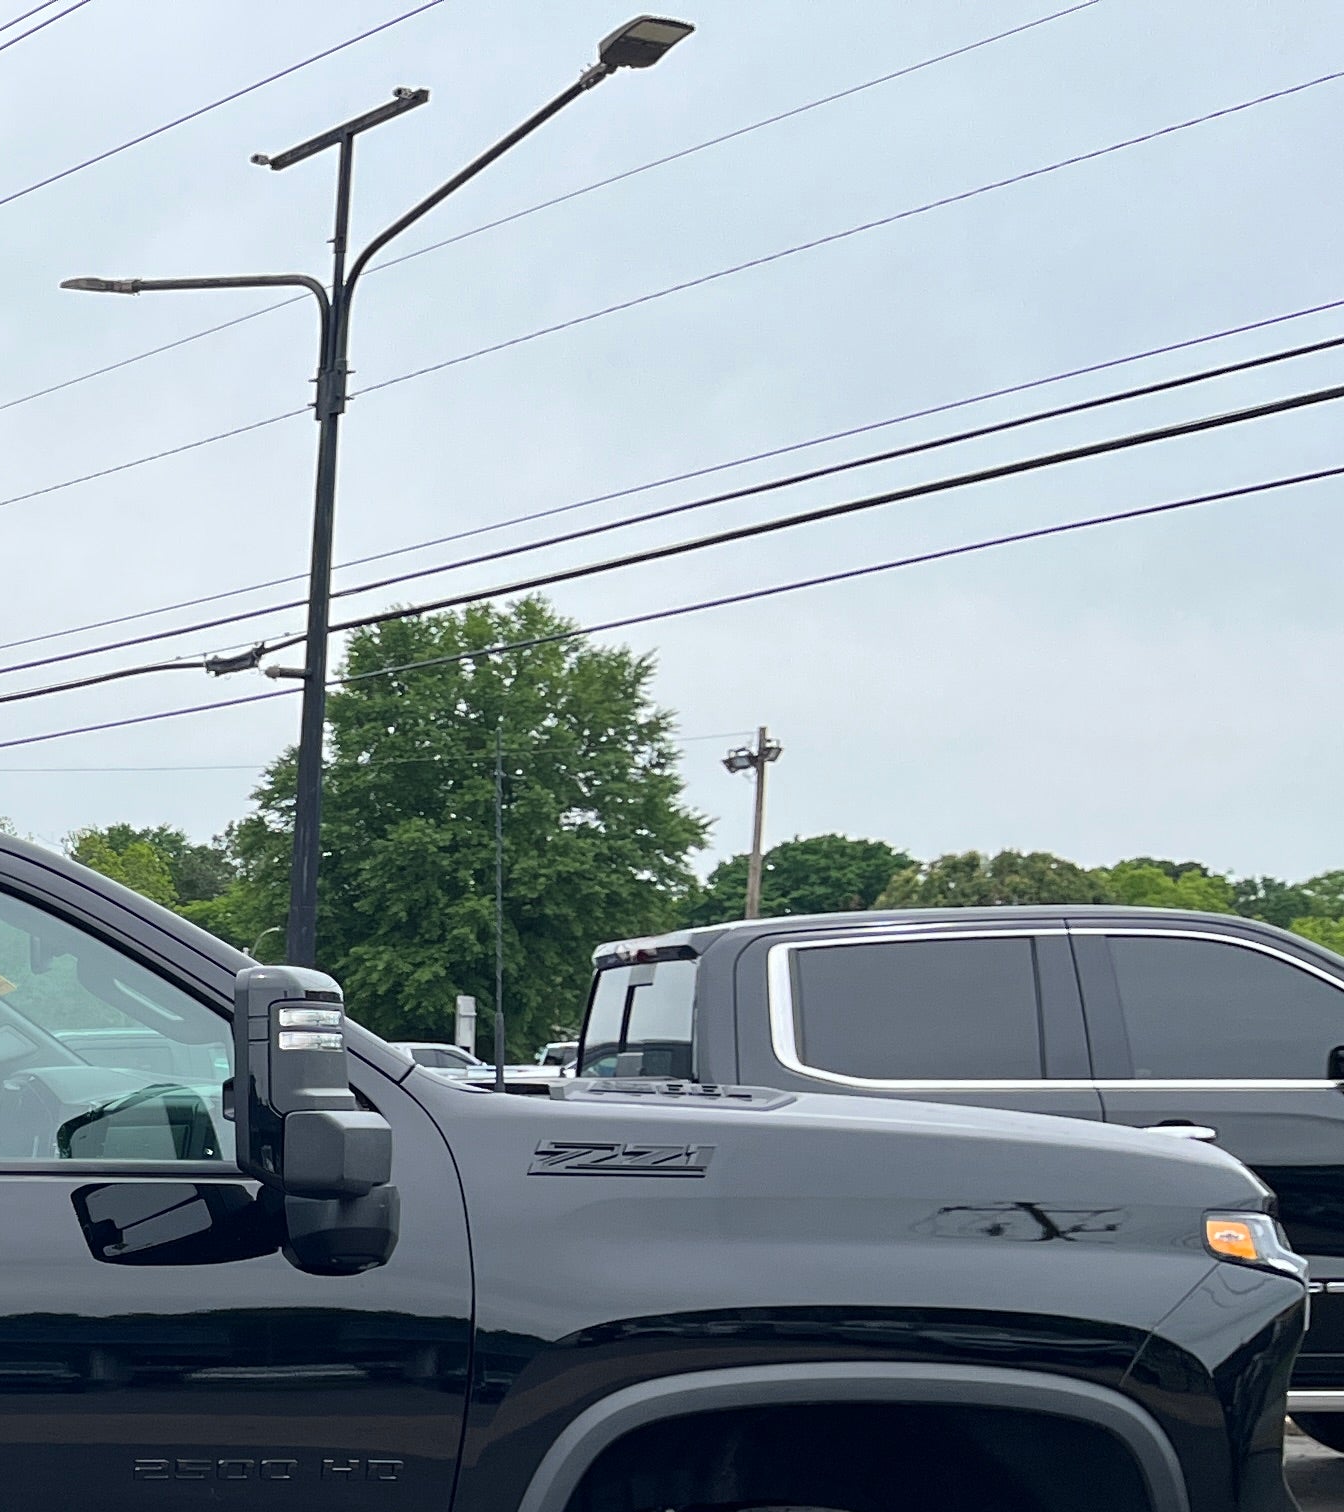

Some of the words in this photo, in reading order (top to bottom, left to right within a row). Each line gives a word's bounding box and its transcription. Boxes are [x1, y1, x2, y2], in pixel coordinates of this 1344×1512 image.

[527, 1140, 717, 1178] Z71
[133, 1459, 299, 1480] 2500
[321, 1459, 404, 1481] HD
